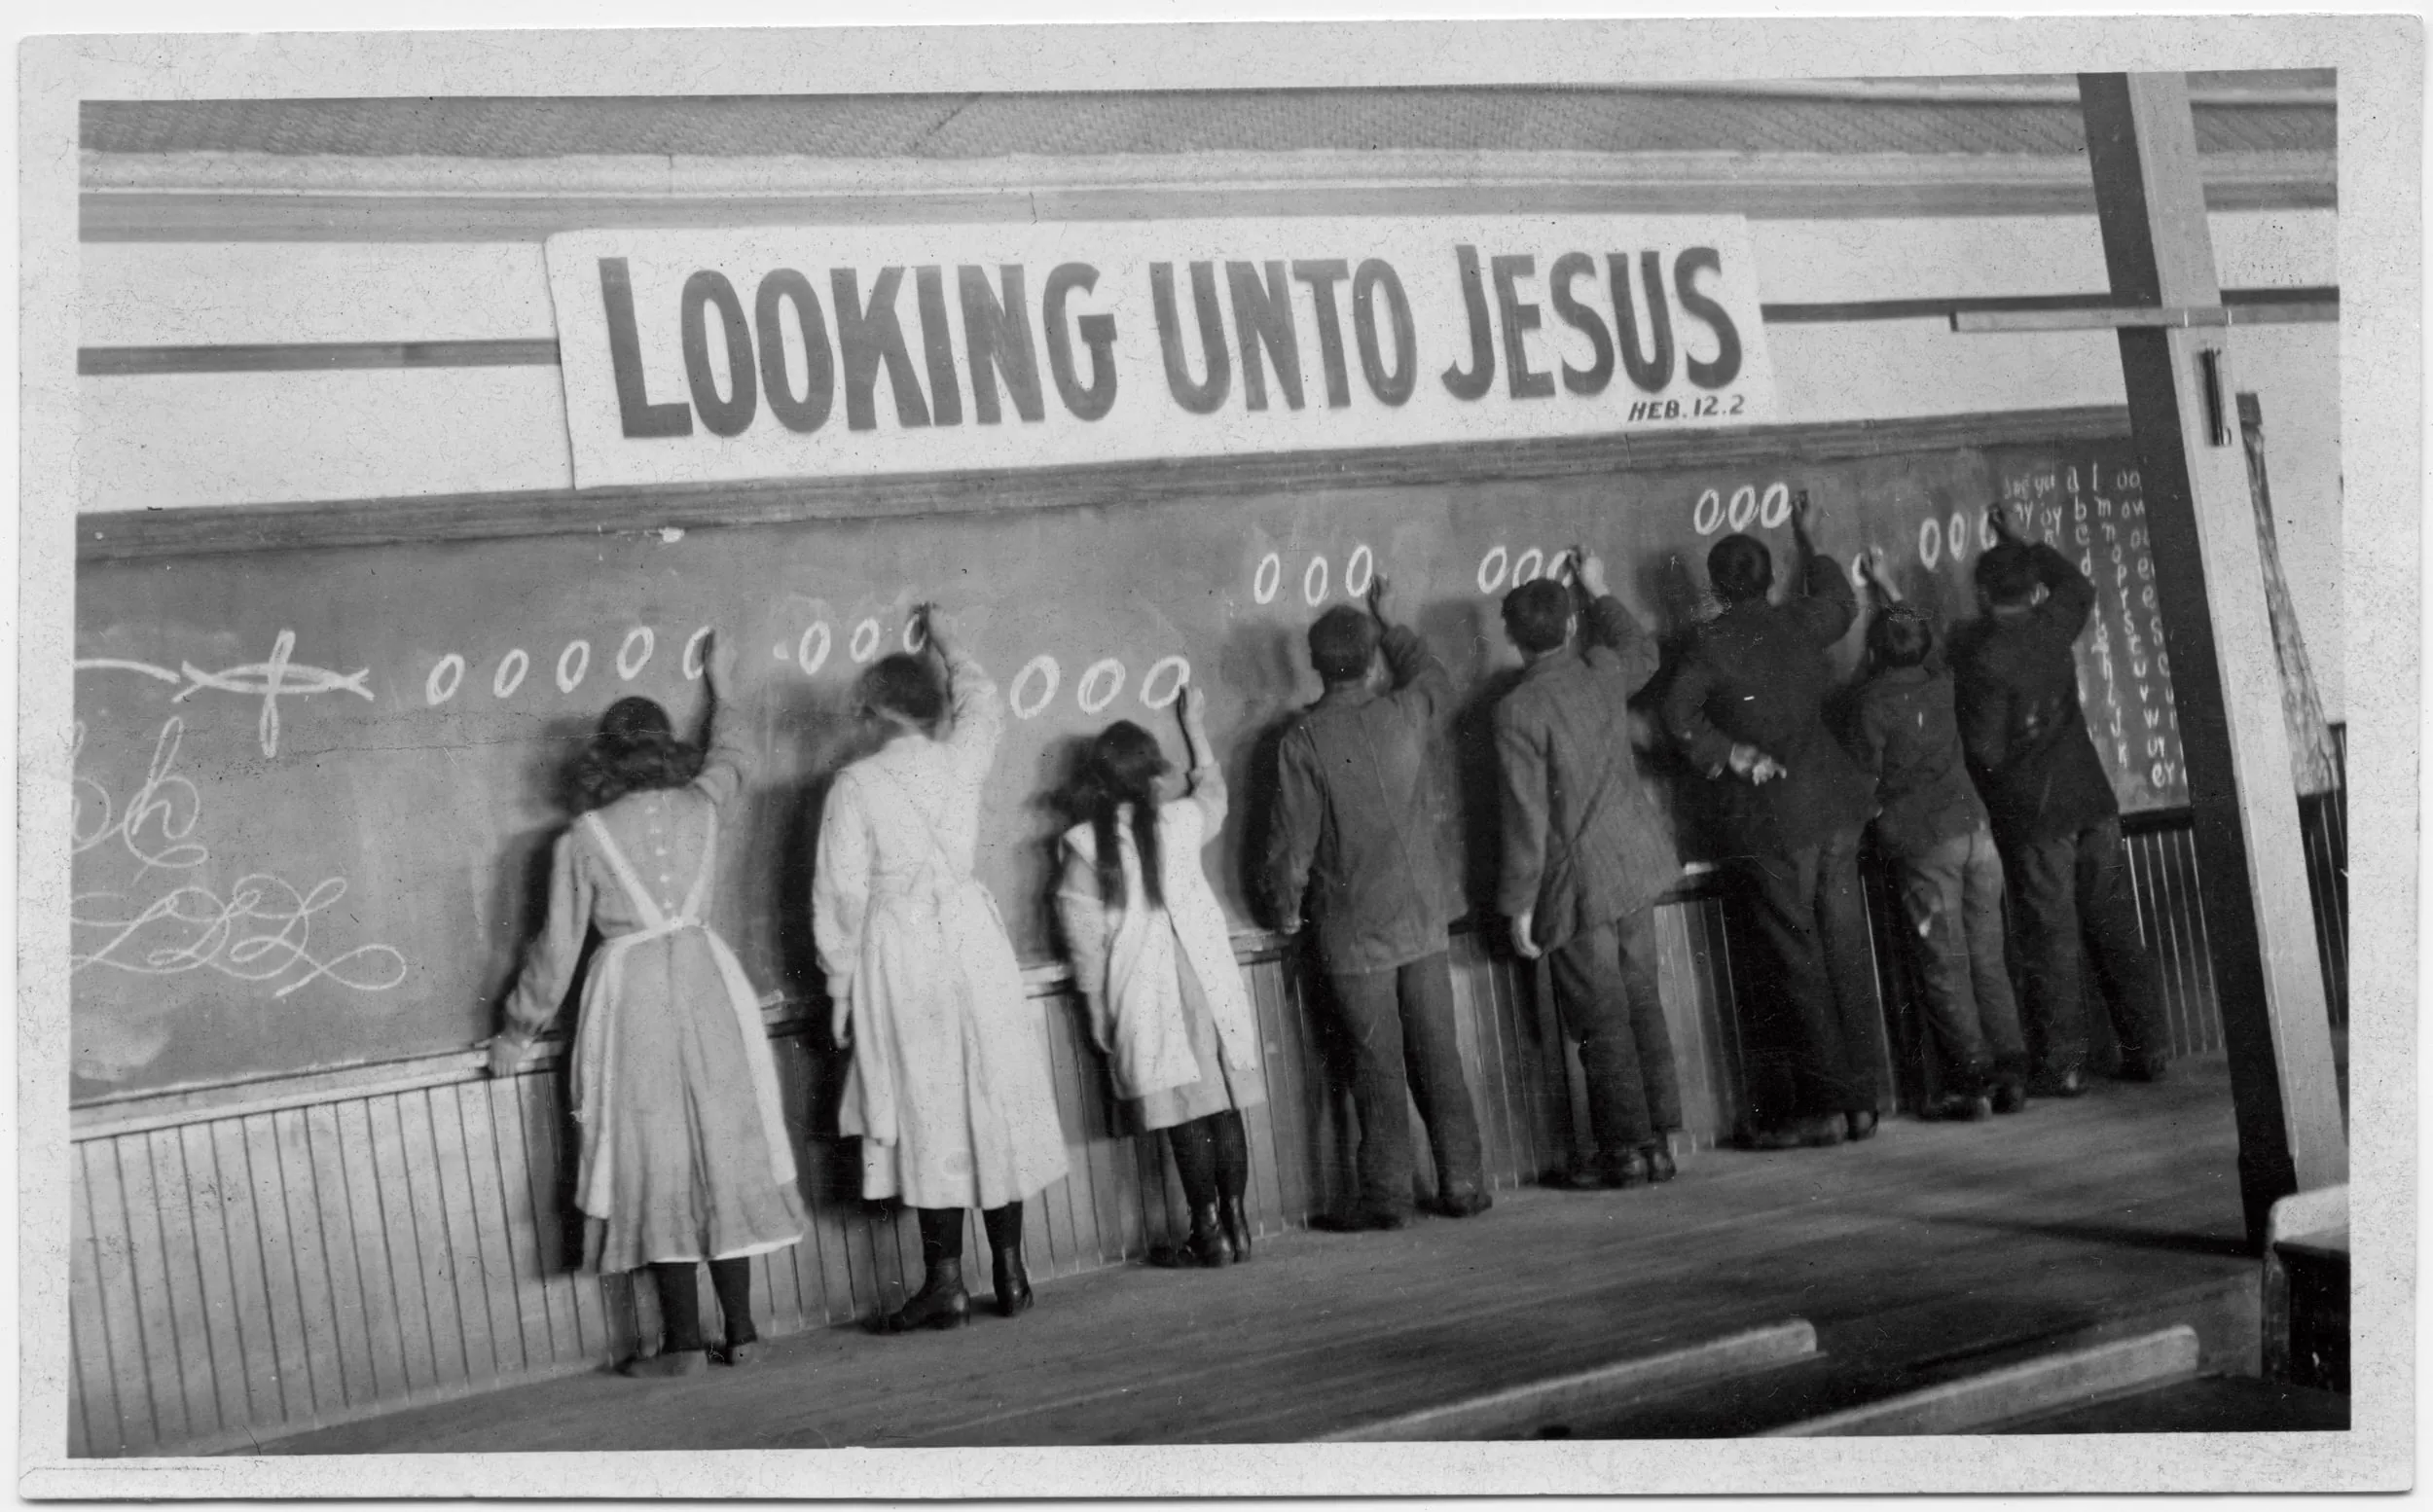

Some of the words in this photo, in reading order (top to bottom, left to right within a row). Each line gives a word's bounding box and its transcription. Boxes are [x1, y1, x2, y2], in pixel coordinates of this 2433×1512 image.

[599, 257, 1116, 438] LOOKING
[1151, 260, 1416, 414] UNTO
[1440, 244, 1745, 402] JESUS
[1628, 399, 1688, 421] HEB.
[1693, 394, 1745, 416] 12.2
